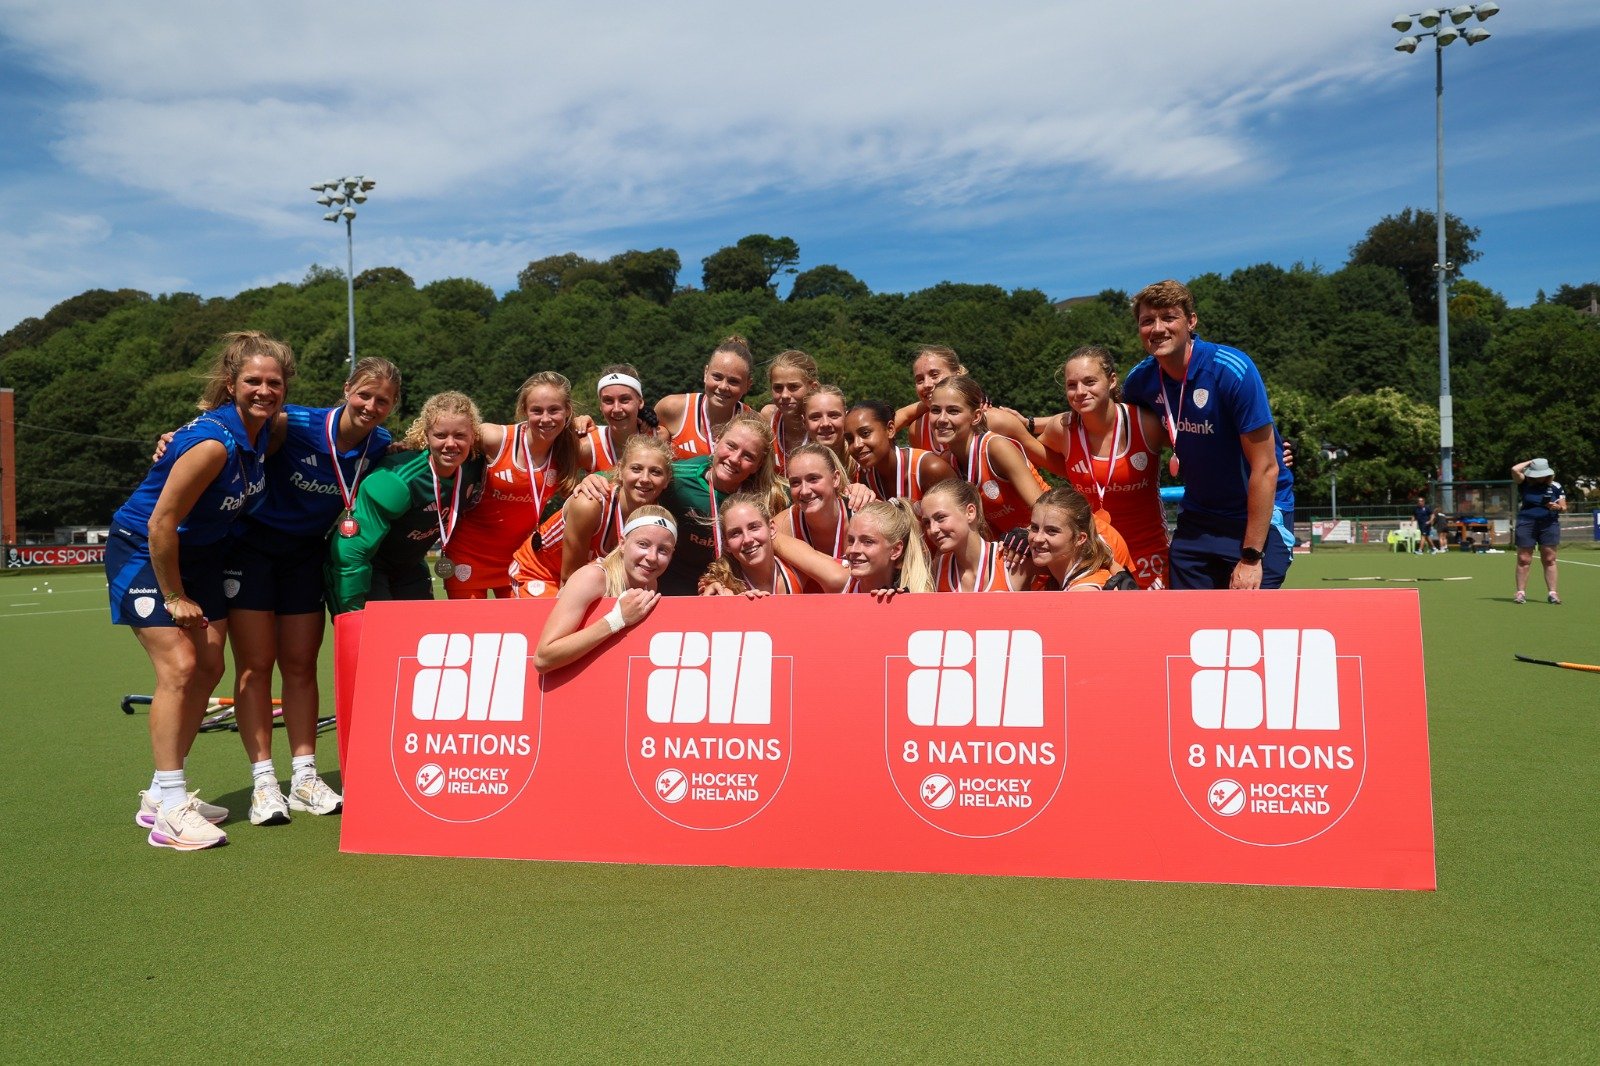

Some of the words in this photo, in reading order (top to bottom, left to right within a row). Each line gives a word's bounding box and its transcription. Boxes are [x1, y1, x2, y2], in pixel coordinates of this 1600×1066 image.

[21, 550, 54, 565] UCC
[57, 549, 106, 563] SPORT
[1136, 554, 1163, 578] 20
[128, 587, 158, 595] Rabobank
[404, 732, 419, 754] 8
[425, 733, 531, 756] NATIONS
[640, 736, 656, 759] 8
[664, 736, 781, 761] NATIONS
[902, 740, 920, 763] 8
[928, 740, 1056, 766] NATIONS
[1188, 743, 1206, 768] 8
[1215, 744, 1354, 770] NATIONS
[448, 767, 509, 782] HOCKEY
[691, 772, 759, 787] HOCKEY
[447, 781, 509, 795] IRELAND
[959, 778, 1032, 793] HOCKEY
[1250, 783, 1329, 799] HOCKEY
[691, 787, 759, 802] IRELAND
[959, 793, 1033, 808] IRELAND
[1250, 799, 1330, 815] IRELAND
